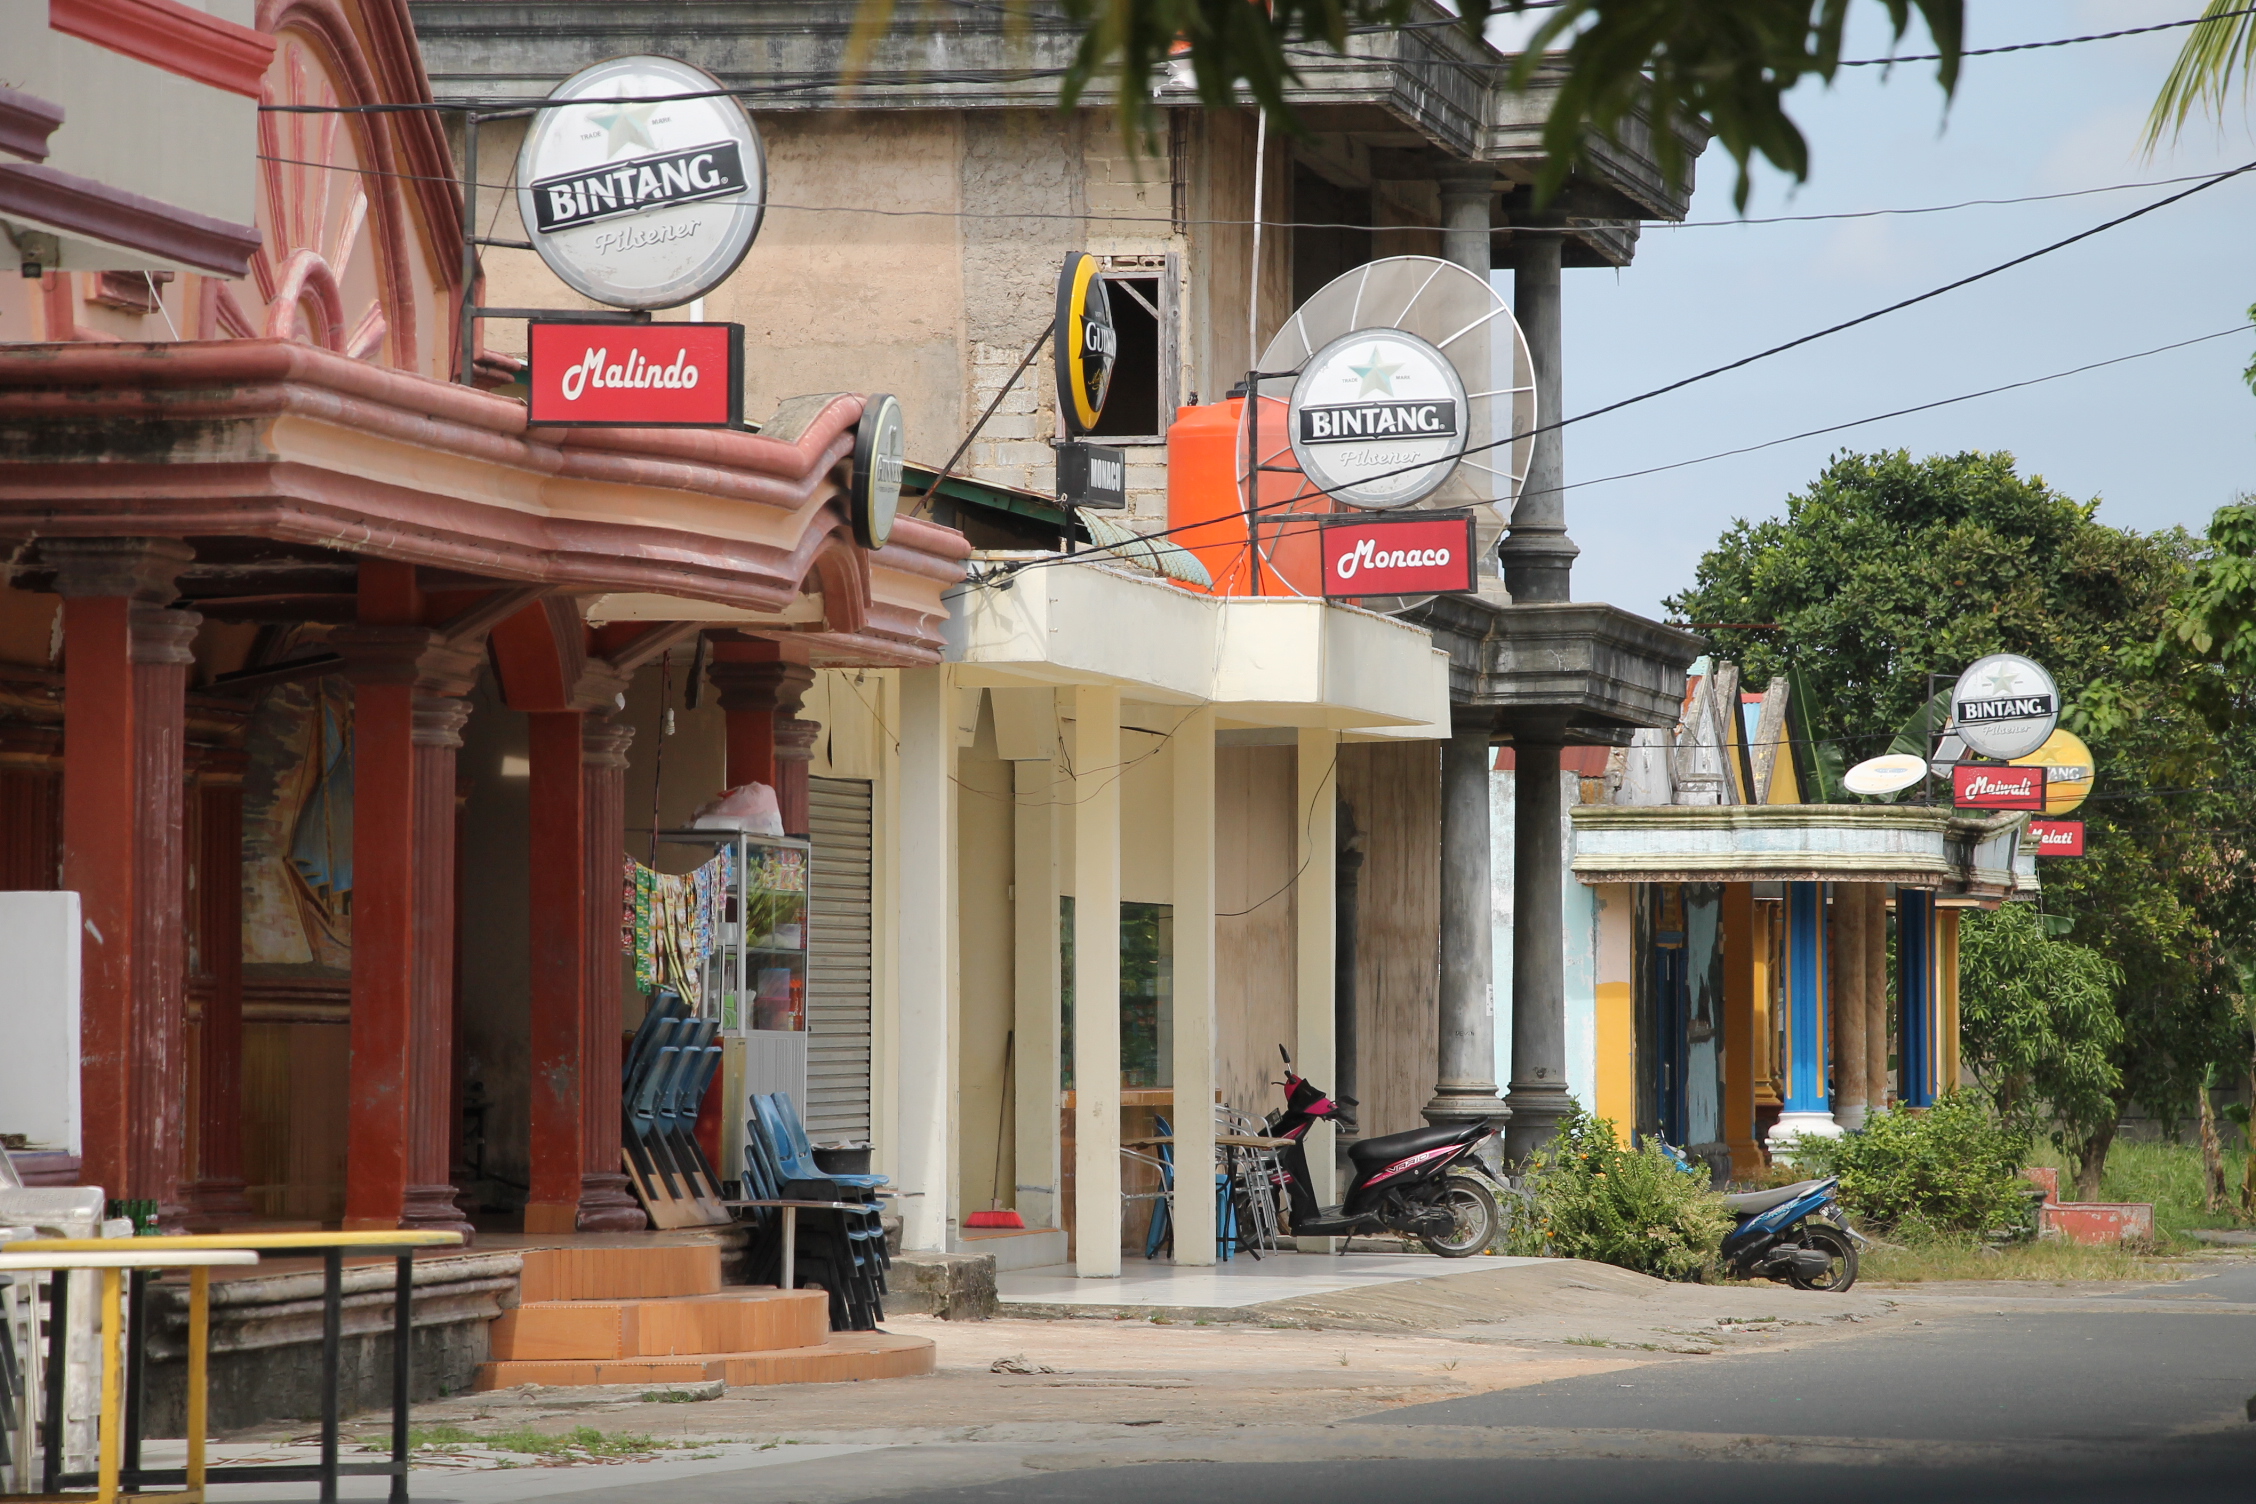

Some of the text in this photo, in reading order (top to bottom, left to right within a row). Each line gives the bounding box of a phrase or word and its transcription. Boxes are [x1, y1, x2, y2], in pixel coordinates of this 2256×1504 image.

[580, 116, 672, 141] TRADE MARK
[548, 154, 721, 221] BINTANG
[594, 220, 702, 255] Pilsener
[562, 347, 698, 400] Malindo
[1311, 405, 1440, 438] BINTANG
[1340, 449, 1421, 467] Pilsener
[1091, 458, 1121, 492] MONACO
[1337, 539, 1450, 579] Monaco
[1964, 698, 2040, 719] BINTANG
[1983, 725, 2032, 736] Pilsener
[1965, 776, 2033, 800] Maiwali
